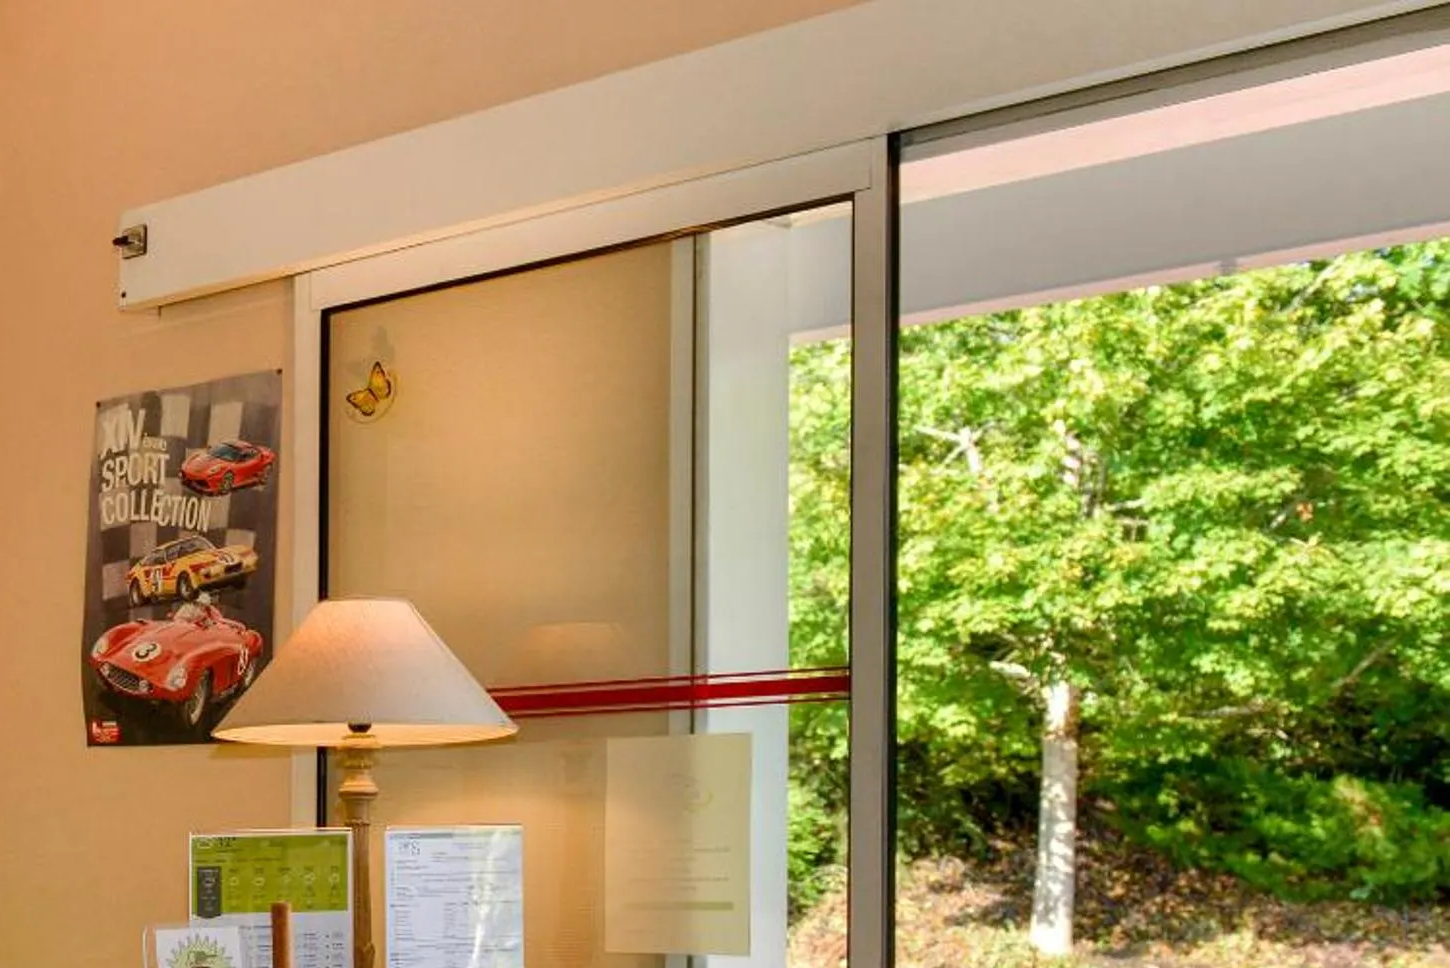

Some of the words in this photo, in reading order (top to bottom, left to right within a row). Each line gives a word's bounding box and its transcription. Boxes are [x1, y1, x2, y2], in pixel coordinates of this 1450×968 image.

[100, 408, 146, 460] XIV
[101, 453, 170, 493] SPORT
[101, 488, 211, 533] COLLECTION
[135, 642, 158, 660] 3
